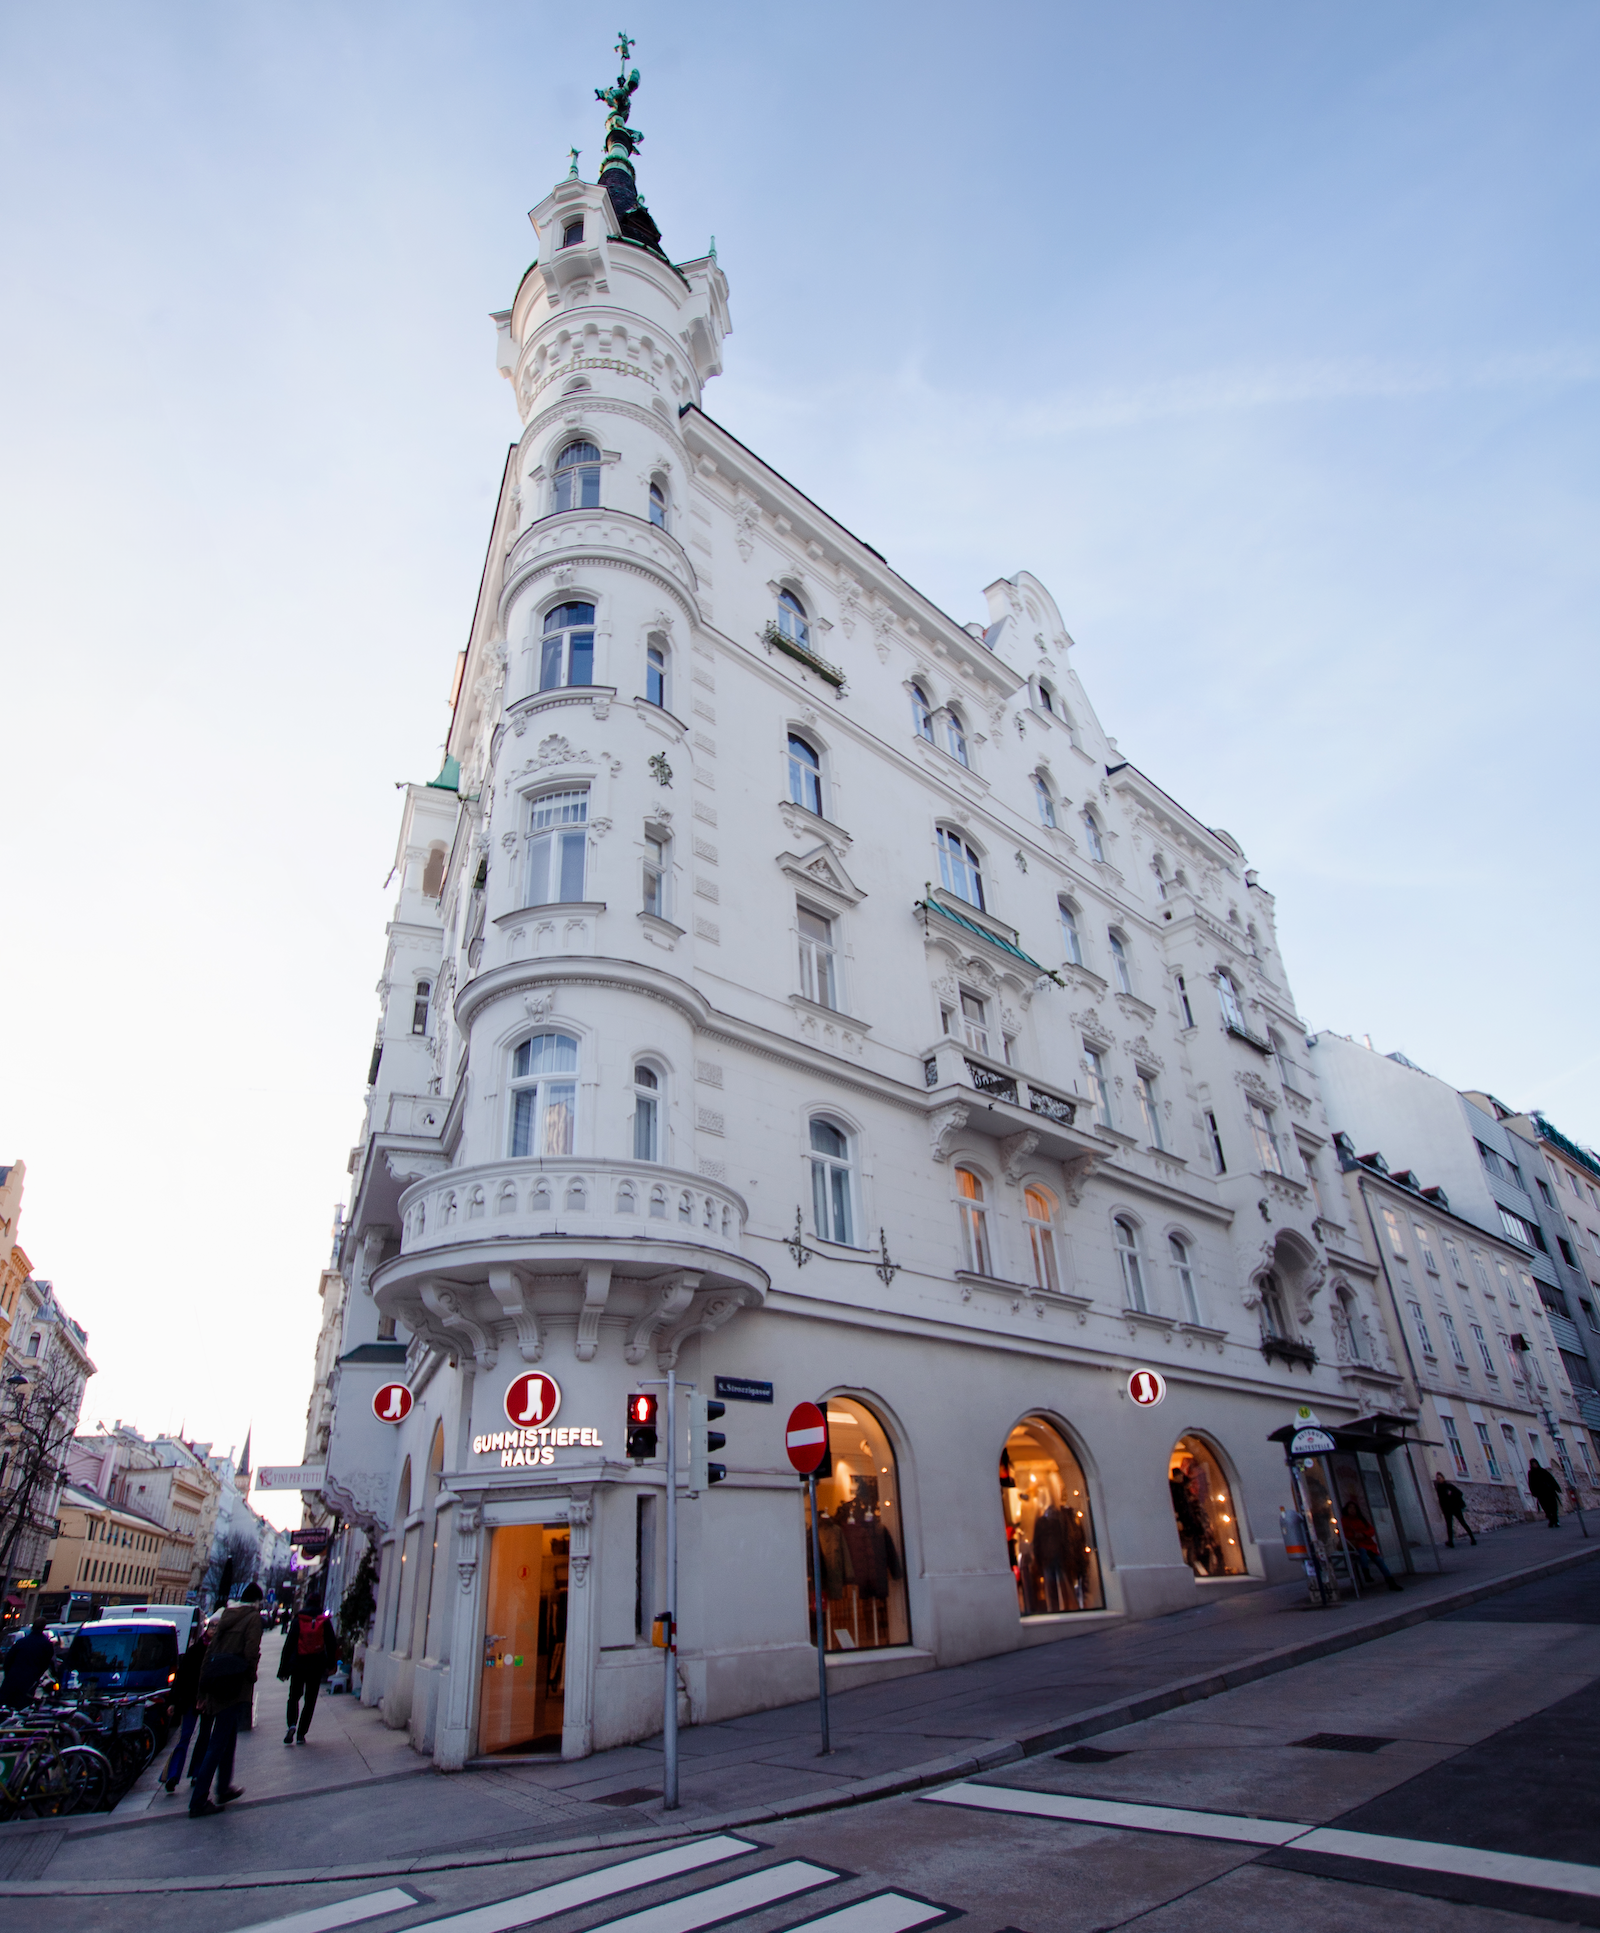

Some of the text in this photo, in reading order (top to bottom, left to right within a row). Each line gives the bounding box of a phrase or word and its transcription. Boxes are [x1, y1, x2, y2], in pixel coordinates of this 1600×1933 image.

[726, 1383, 771, 1397] Strozzigasse
[473, 1427, 603, 1454] GUMMISTIEFEL
[1295, 1443, 1330, 1451] HALTESTELLE
[501, 1446, 555, 1468] HAUS
[273, 1471, 322, 1483] VINI PER TUTTI
